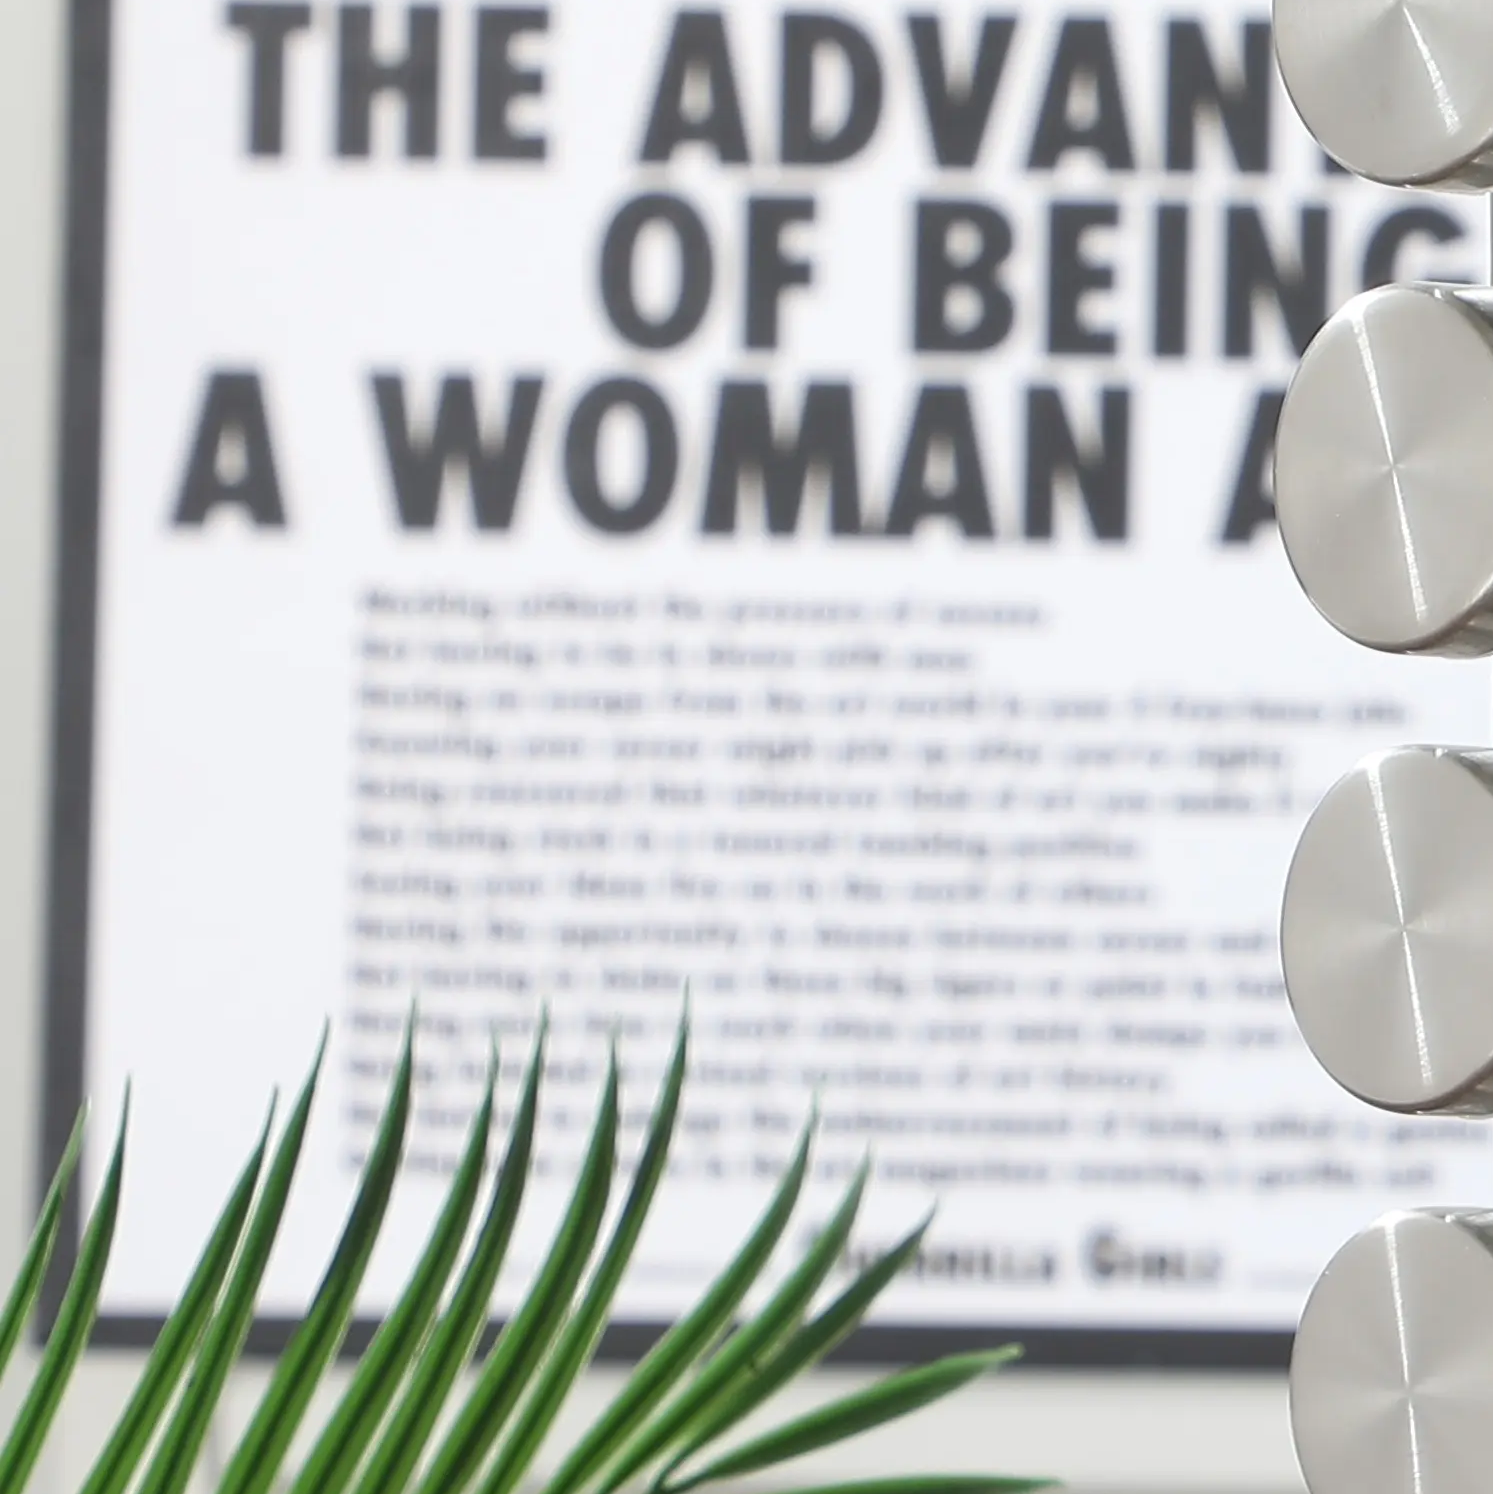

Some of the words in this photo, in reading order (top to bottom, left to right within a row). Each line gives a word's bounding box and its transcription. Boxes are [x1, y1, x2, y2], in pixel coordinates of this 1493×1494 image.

[226, 1, 550, 161] THE
[641, 7, 1345, 175] ADVAN
[599, 191, 816, 353] OF
[172, 369, 287, 529] A
[369, 375, 1130, 543] WOMAN
